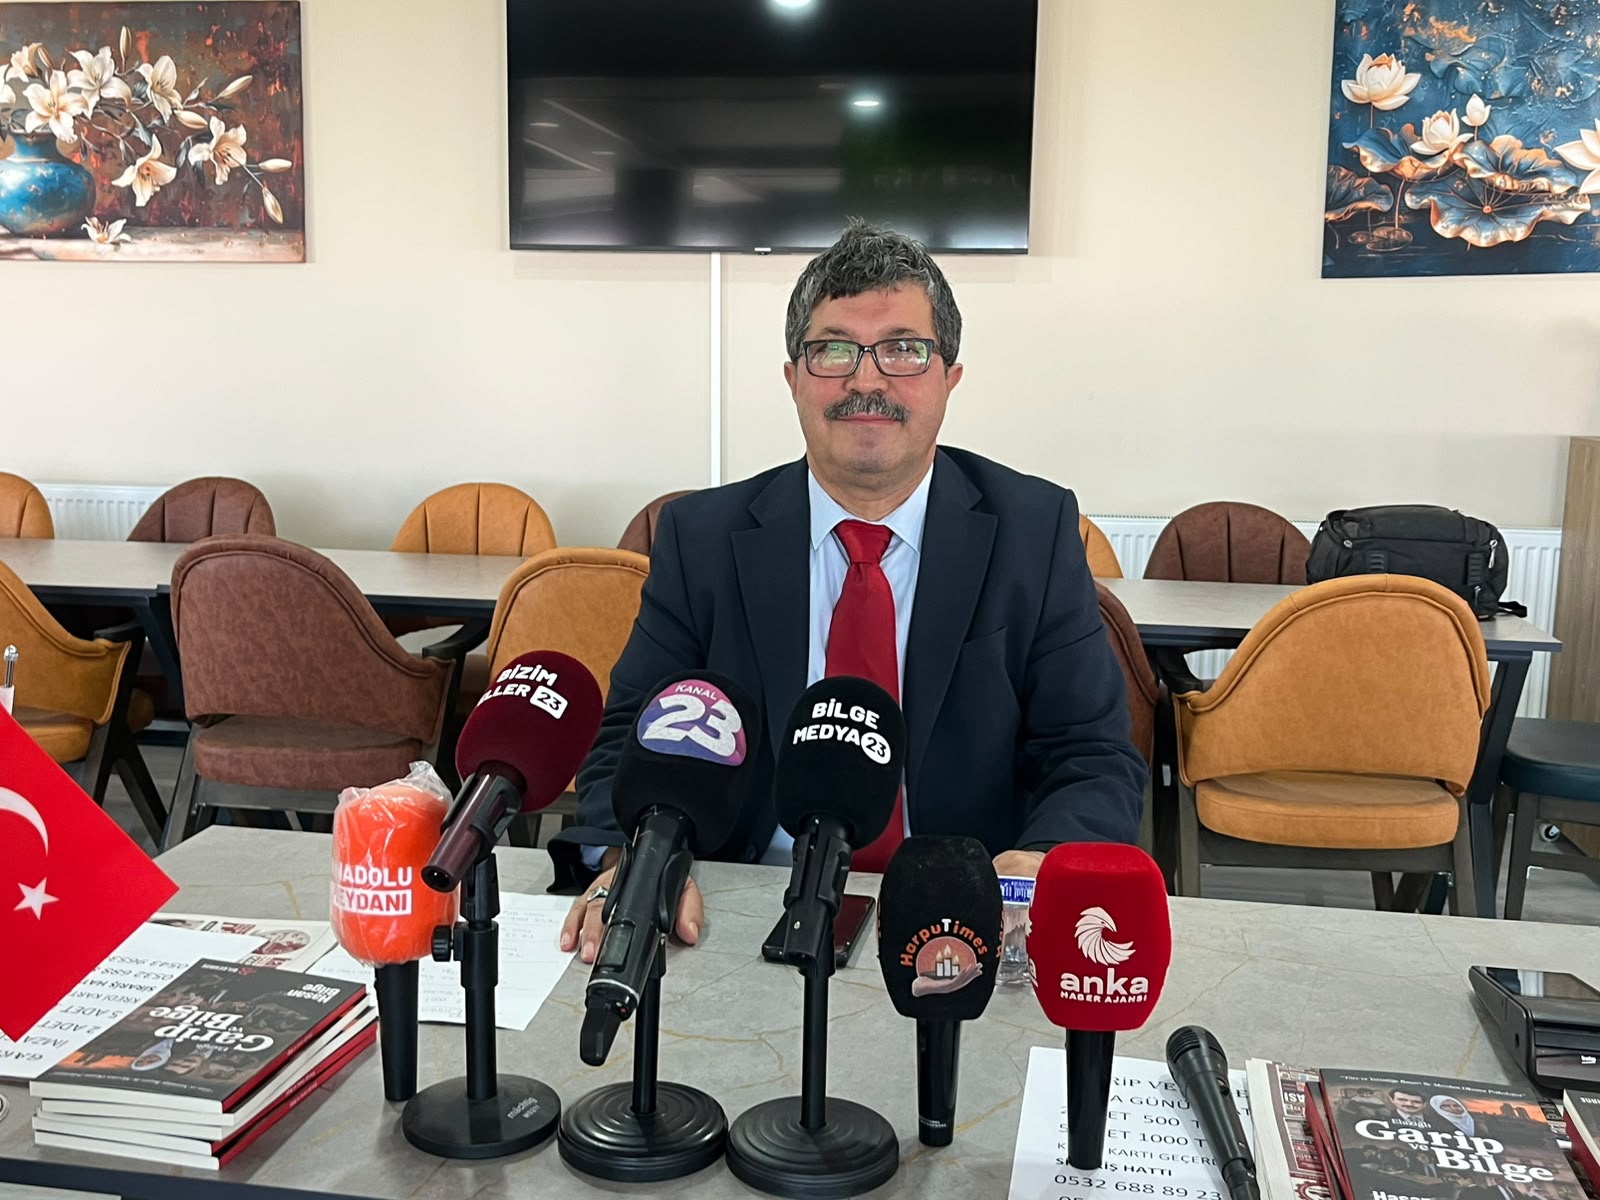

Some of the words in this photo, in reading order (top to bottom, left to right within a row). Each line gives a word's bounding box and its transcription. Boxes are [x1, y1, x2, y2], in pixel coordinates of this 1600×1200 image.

[496, 664, 558, 687] BİZİM
[674, 684, 717, 700] KANAL
[536, 691, 562, 711] 23
[811, 698, 880, 730] BİLGE
[642, 694, 742, 757] 23
[792, 724, 862, 746] MEDYA
[864, 736, 888, 759] 23
[339, 862, 413, 888] ADOLU
[335, 888, 408, 912] EYDANI
[899, 918, 988, 967] HarpuTimes
[302, 983, 341, 997] Bilge
[1059, 967, 1149, 996] anka
[287, 989, 334, 1004] Hasan
[1060, 991, 1102, 1003] HABER
[1104, 994, 1148, 1004] AJANSI
[59, 1005, 108, 1017] ADET
[112, 1011, 123, 1019] 5
[148, 1004, 244, 1031] Bilge
[37, 1020, 84, 1032] ADET
[87, 1025, 100, 1034] 2
[153, 1023, 274, 1053] Garip
[1112, 1076, 1141, 1087] RİP
[1129, 1095, 1191, 1111] GÜNÜ
[1107, 1111, 1132, 1121] ET
[1143, 1114, 1180, 1127] 500
[1107, 1129, 1132, 1139] ET
[1138, 1132, 1189, 1146] 1000
[1354, 1118, 1504, 1156] Garip
[1108, 1147, 1154, 1159] KARTI
[1408, 1141, 1431, 1151] ve
[1123, 1164, 1172, 1177] HATTI
[1430, 1146, 1555, 1183] Bilge
[1054, 1174, 1107, 1190] 0532
[1114, 1181, 1155, 1195] 688
[1162, 1185, 1188, 1198] 89
[1196, 1189, 1222, 1200] 23
